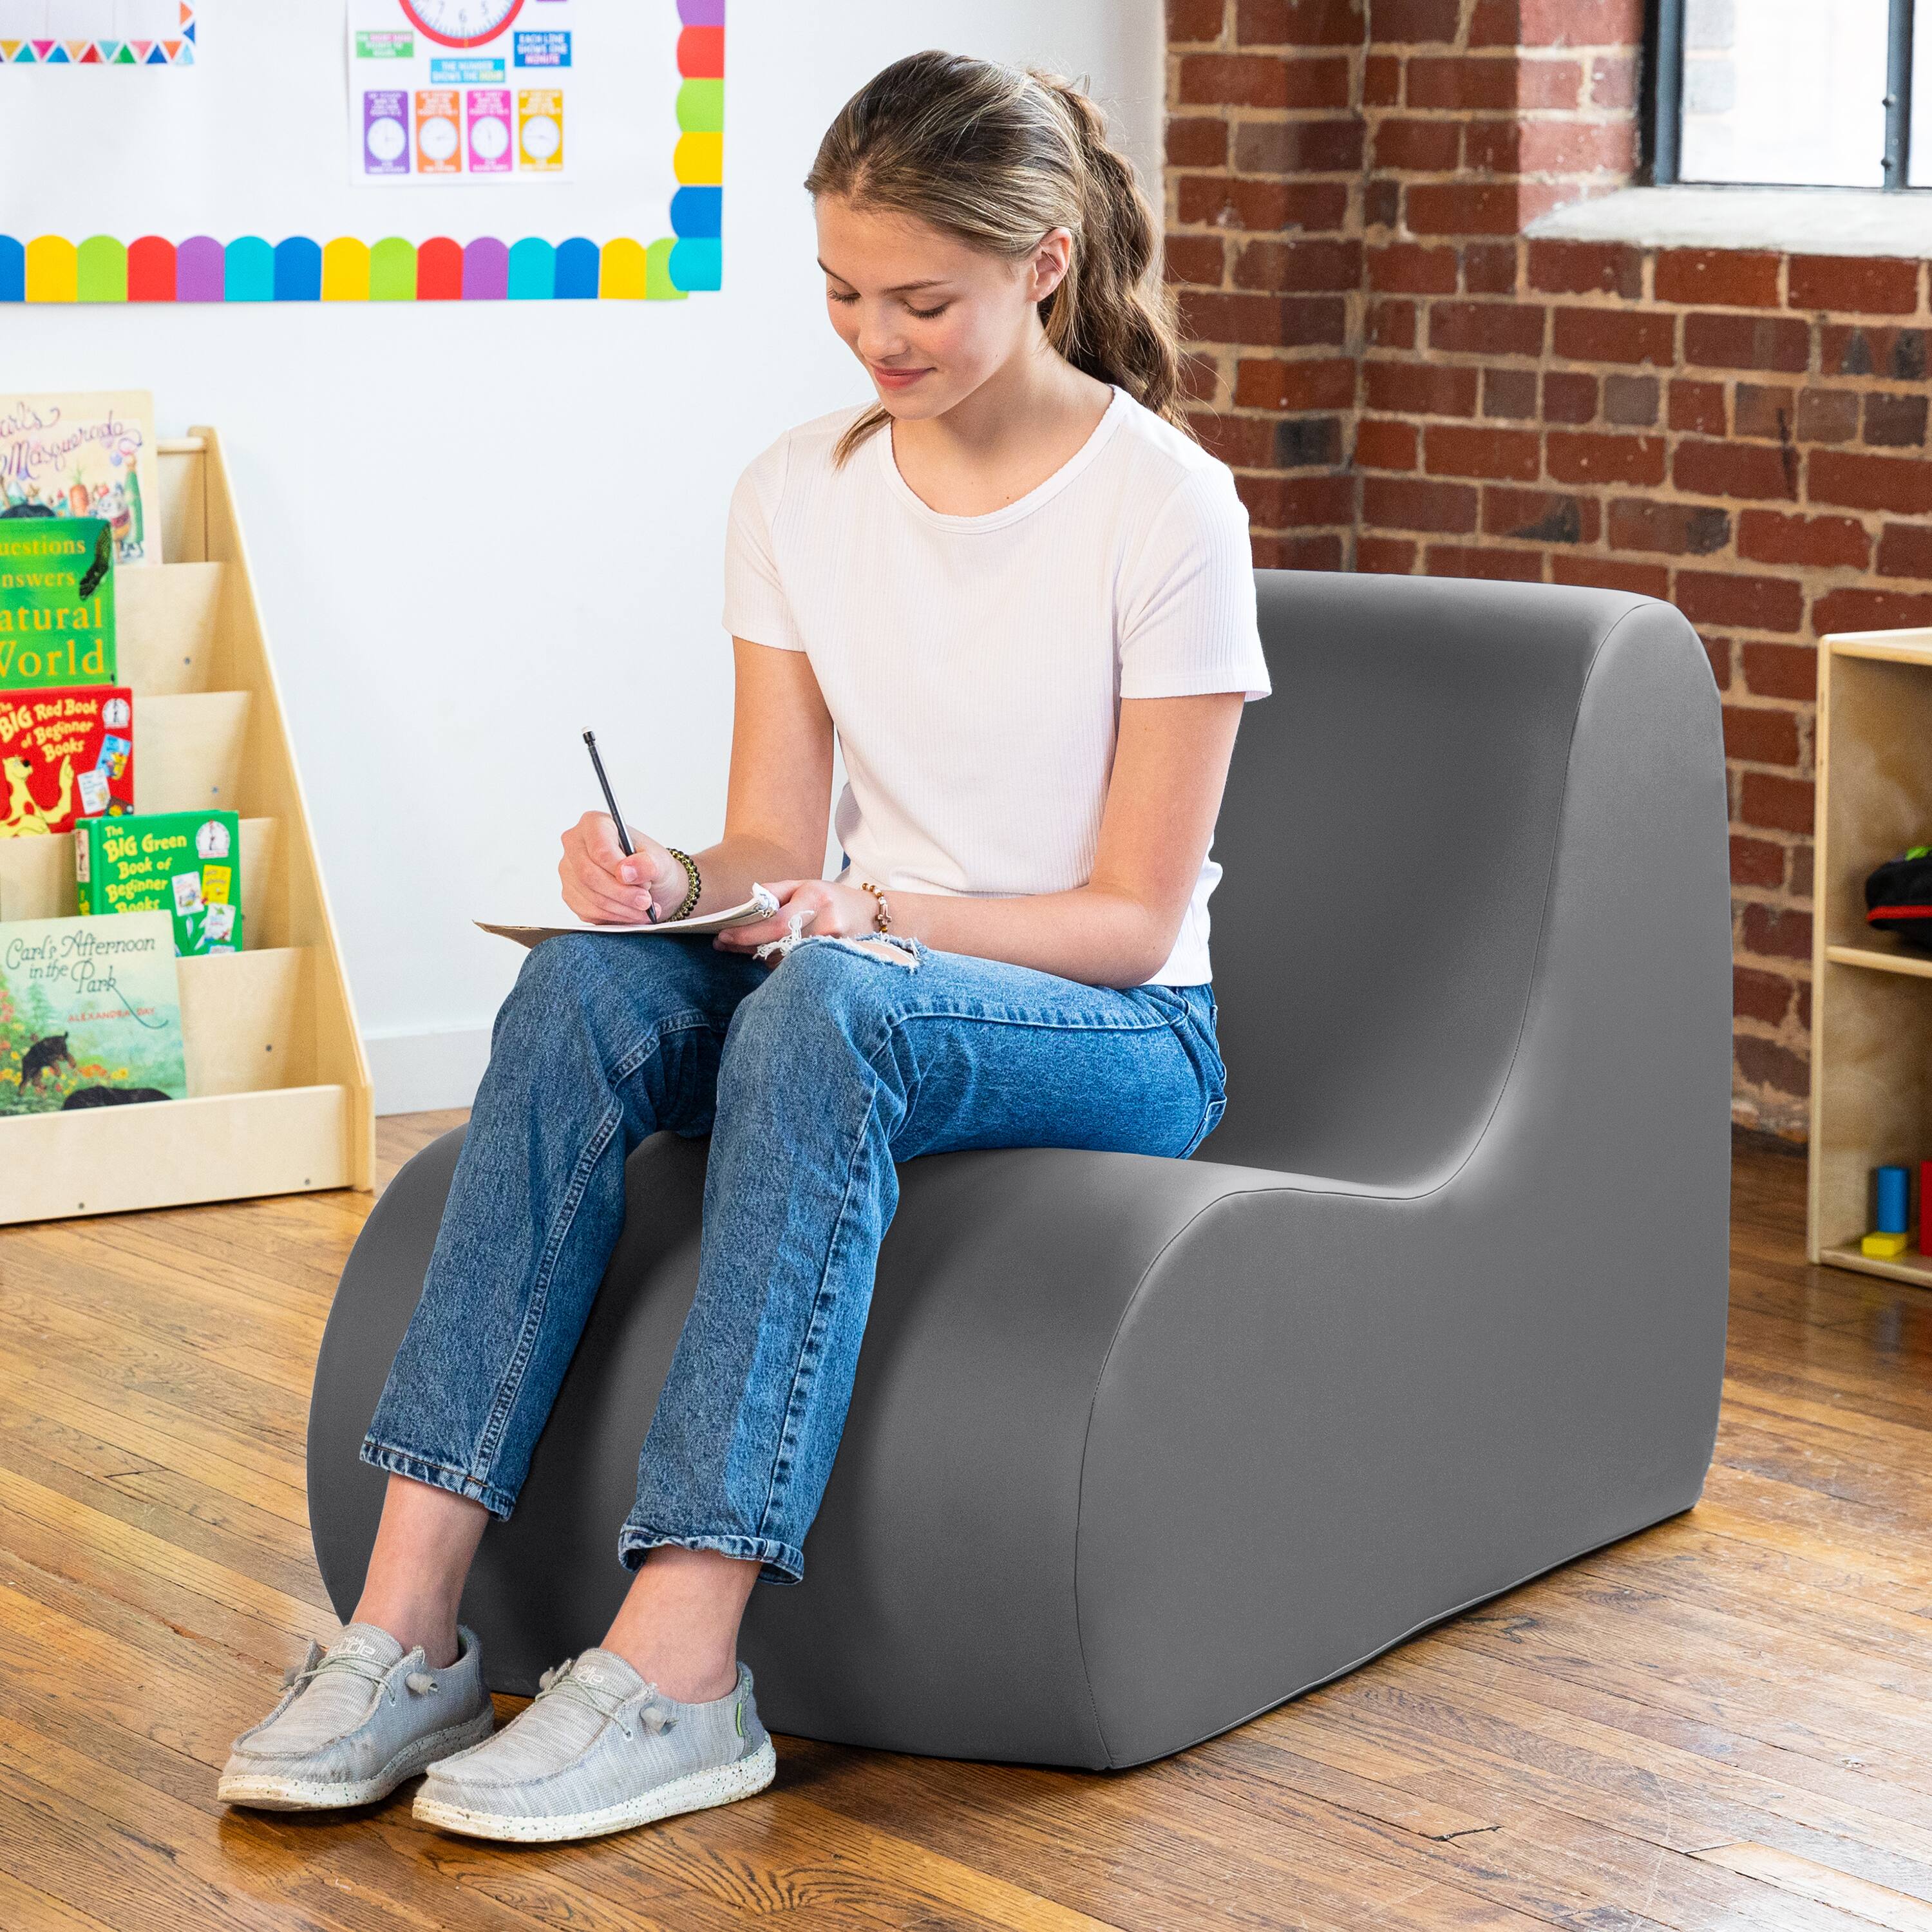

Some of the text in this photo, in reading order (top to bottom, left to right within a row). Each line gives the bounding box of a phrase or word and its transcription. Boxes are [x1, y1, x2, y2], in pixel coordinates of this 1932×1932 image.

[0, 698, 98, 743] BIG Red Book
[21, 732, 32, 749] of
[33, 721, 94, 746] Beginner
[41, 737, 85, 762] Books
[104, 825, 124, 838] The
[102, 833, 187, 863] BIG Green
[117, 857, 173, 880] Book of
[105, 879, 168, 904] Beginner
[6, 930, 155, 969] Carl's Afternoon
[29, 962, 43, 979] in
[46, 958, 69, 983] the
